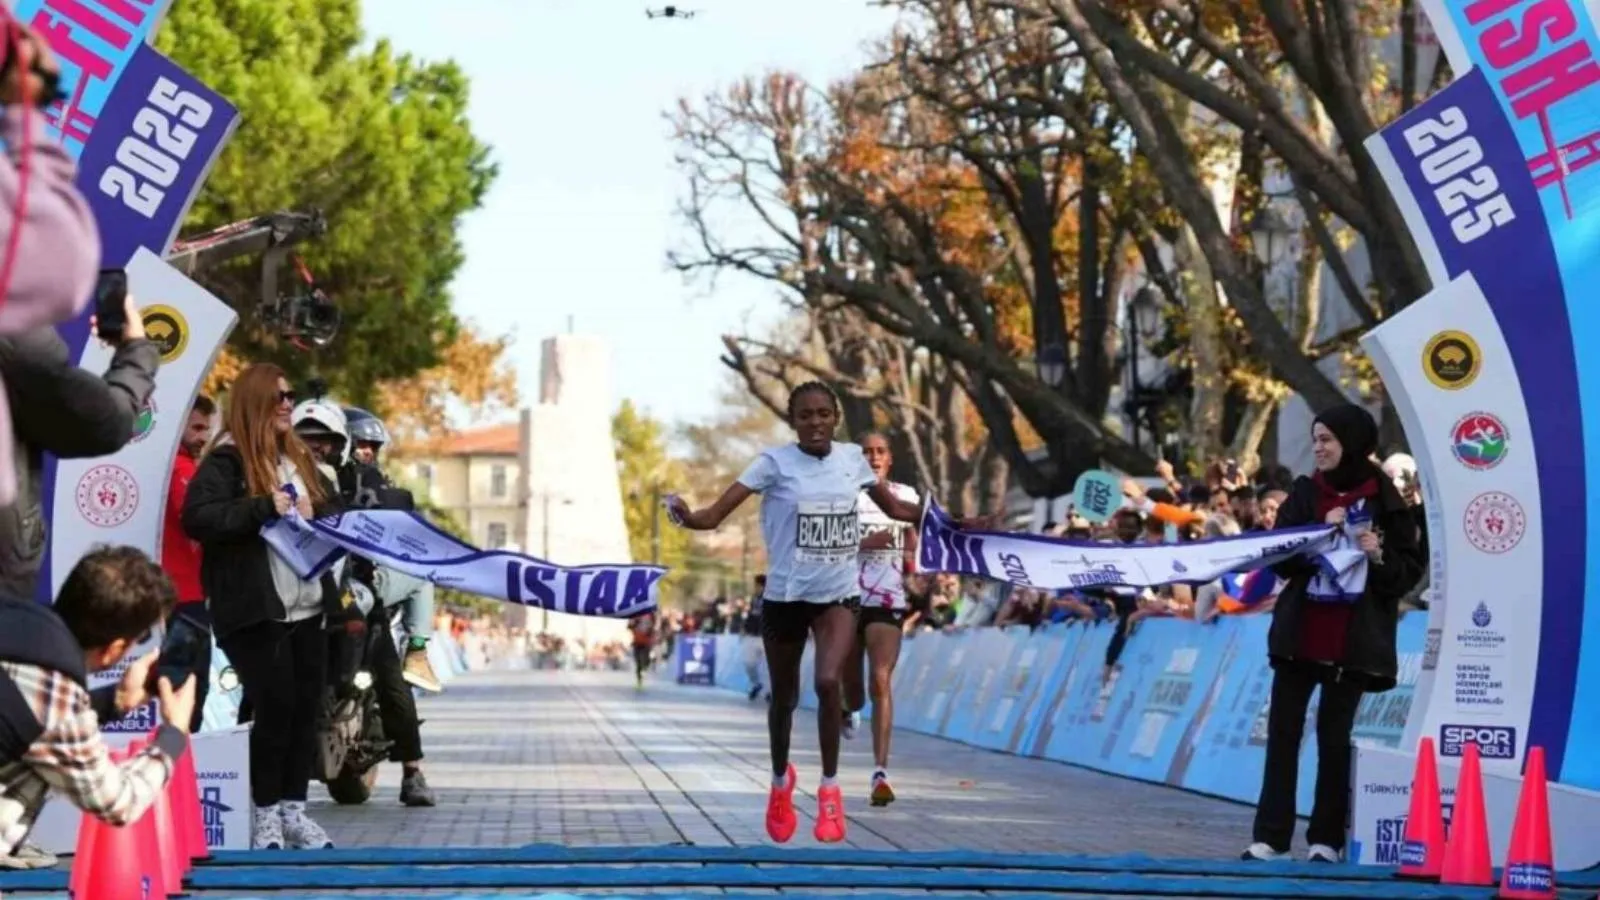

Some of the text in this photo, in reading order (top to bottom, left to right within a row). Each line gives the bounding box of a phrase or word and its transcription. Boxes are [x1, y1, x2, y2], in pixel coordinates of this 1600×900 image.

[99, 75, 214, 219] 2025
[1403, 106, 1516, 243] 2025
[1444, 727, 1511, 745] SPOR
[1363, 783, 1409, 796] TÜRKİYE
[1508, 874, 1552, 889] TIMING
